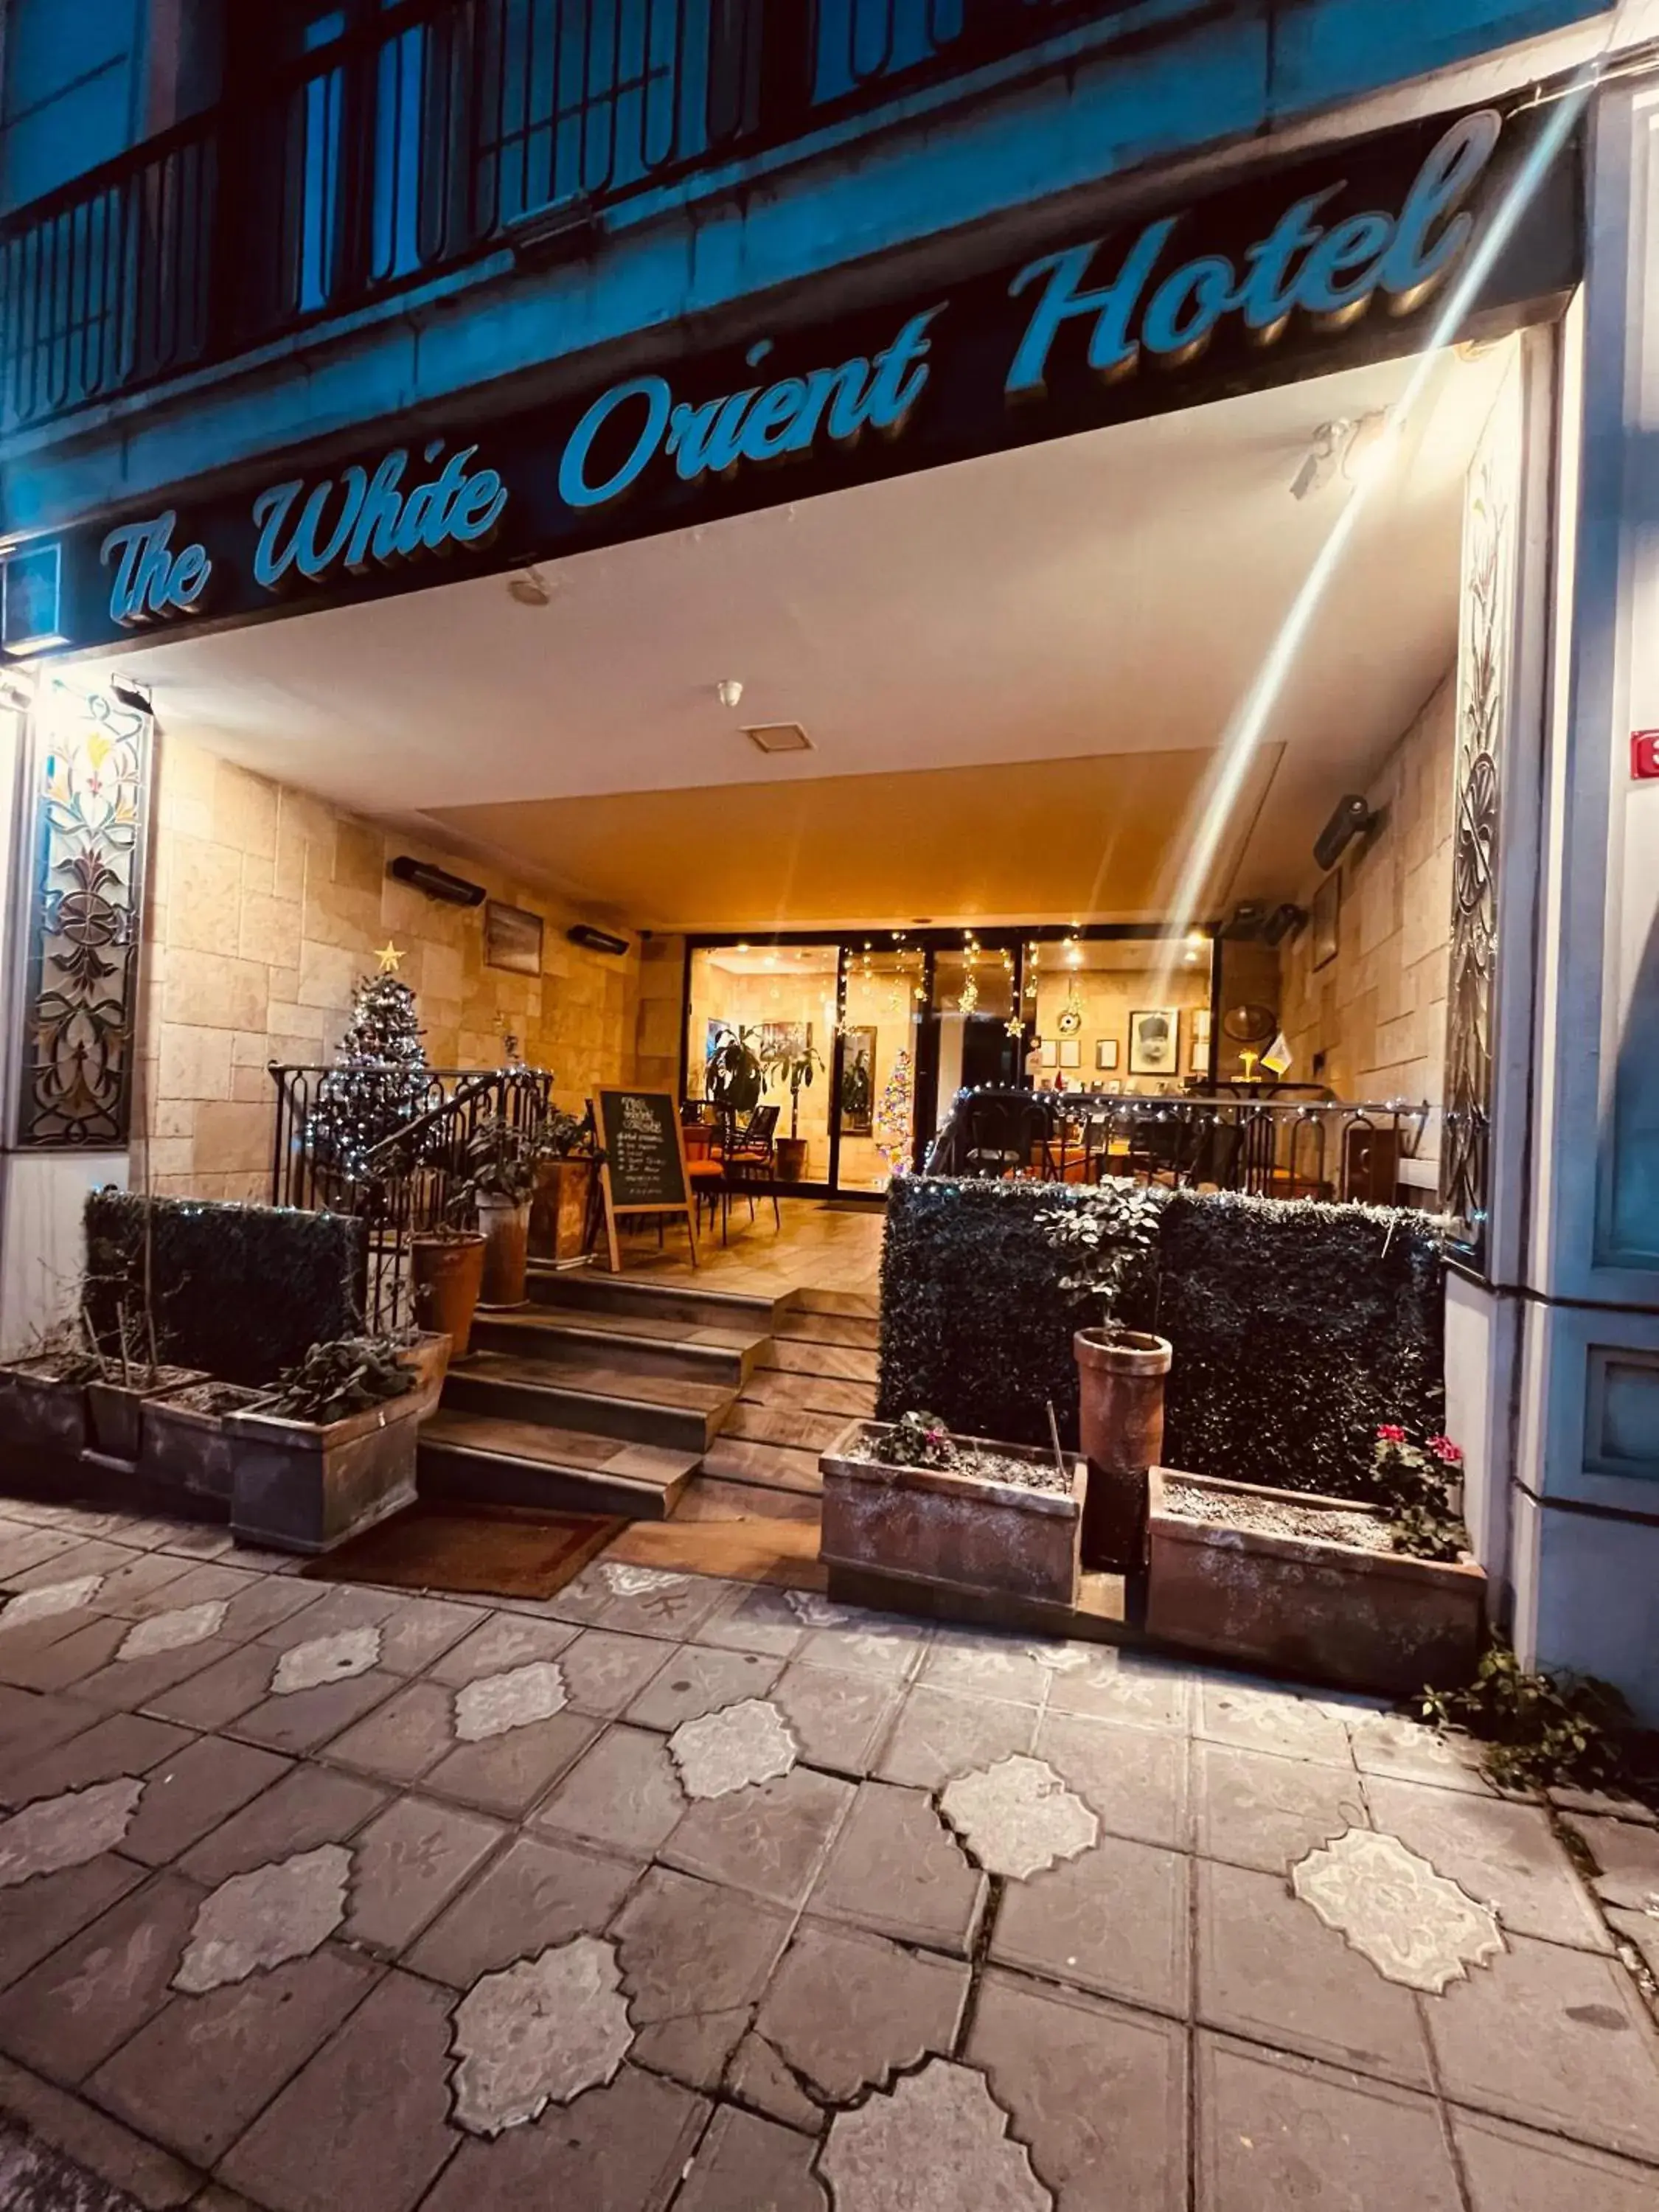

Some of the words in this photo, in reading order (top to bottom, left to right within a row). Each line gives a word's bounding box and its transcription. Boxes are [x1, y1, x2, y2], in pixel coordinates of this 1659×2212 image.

[100, 509, 212, 627] The
[252, 438, 508, 588] White
[558, 300, 950, 507] Orient
[1004, 108, 1503, 392] Hotel
